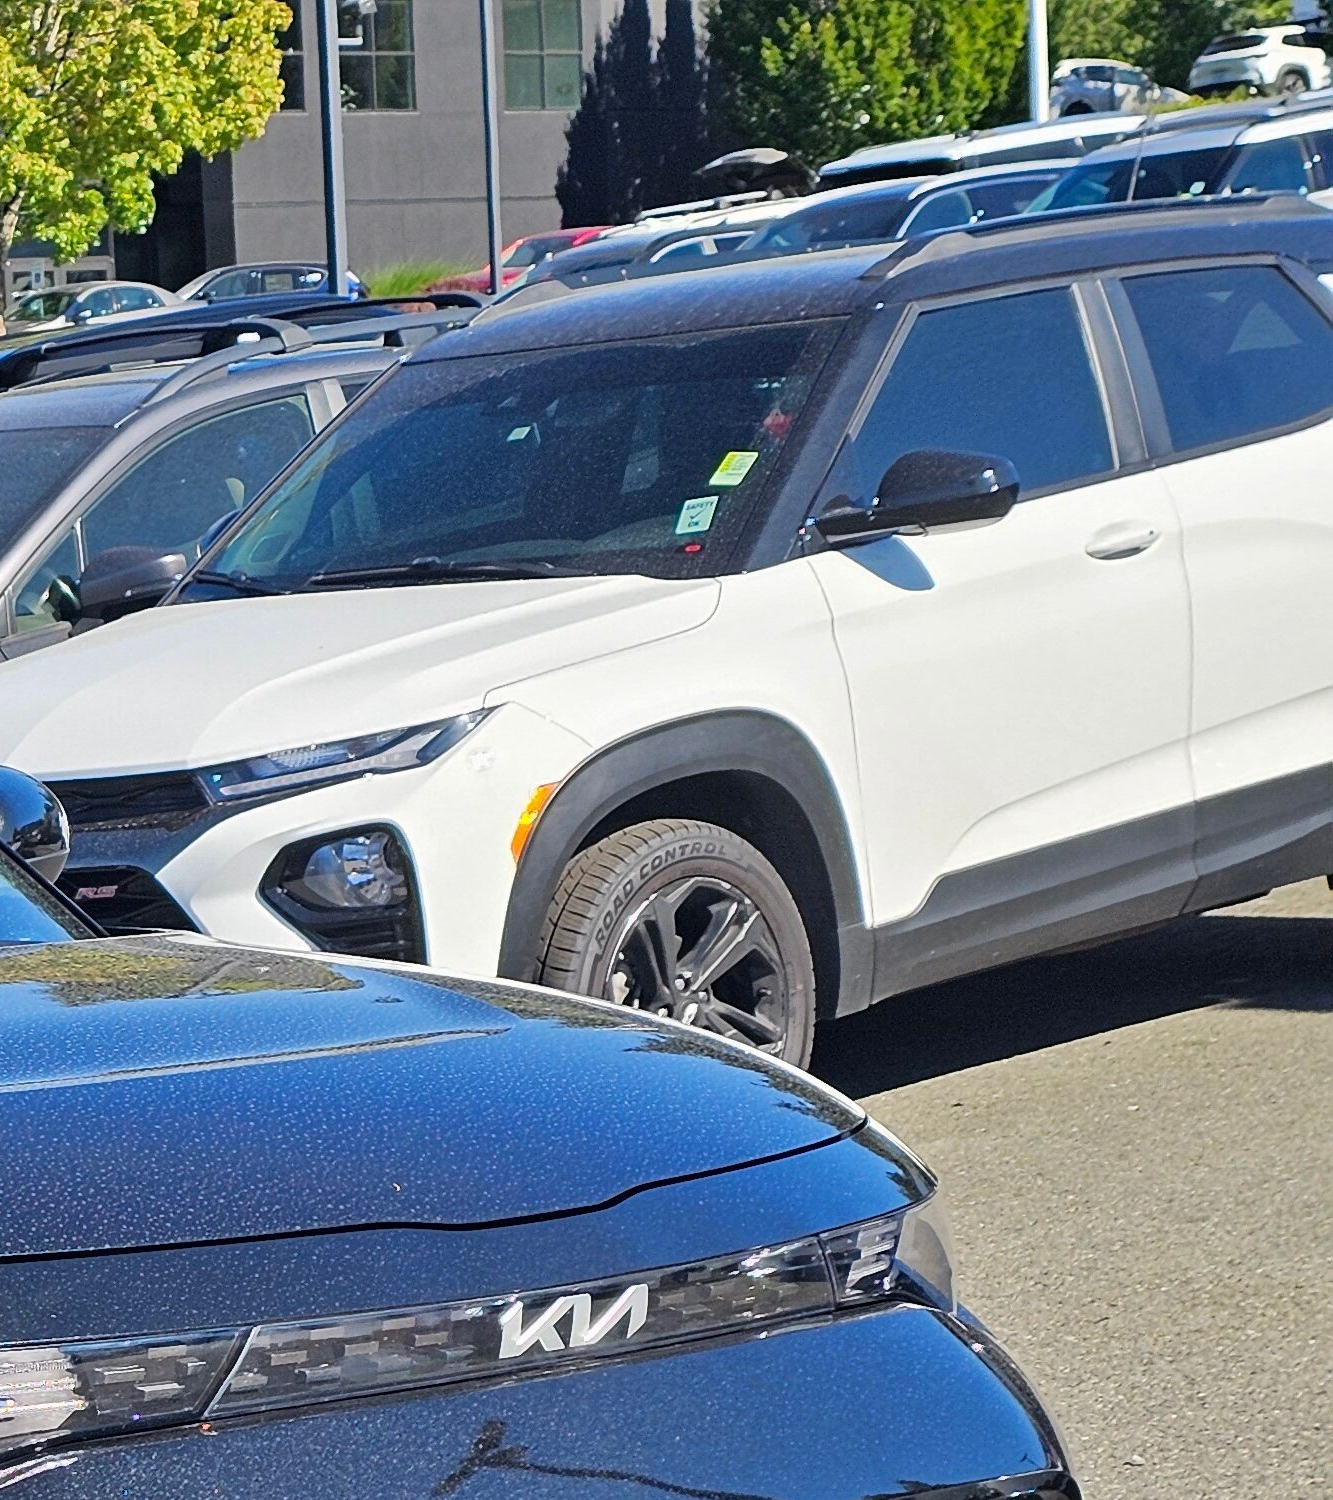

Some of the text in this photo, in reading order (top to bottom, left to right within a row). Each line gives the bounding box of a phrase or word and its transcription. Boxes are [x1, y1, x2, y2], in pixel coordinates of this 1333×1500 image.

[74, 885, 119, 900] RS
[595, 842, 728, 949] ROAD CONTROL
